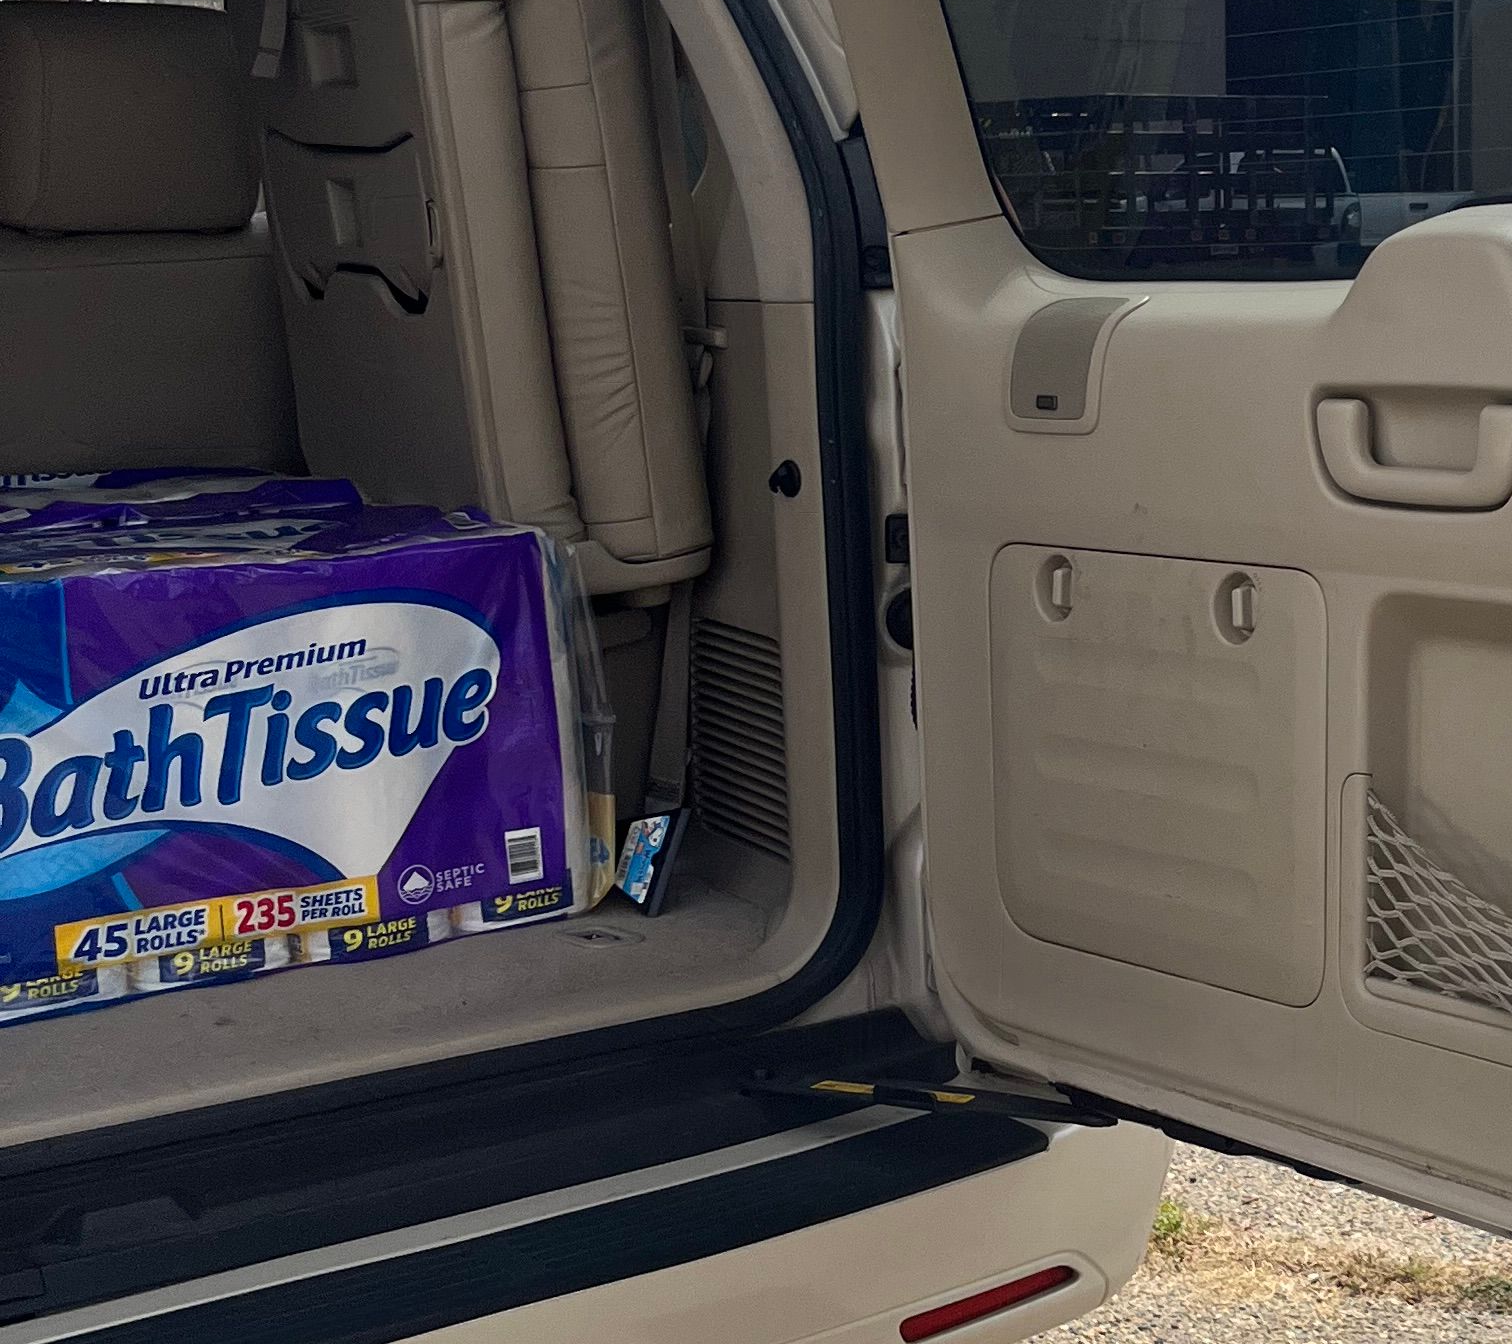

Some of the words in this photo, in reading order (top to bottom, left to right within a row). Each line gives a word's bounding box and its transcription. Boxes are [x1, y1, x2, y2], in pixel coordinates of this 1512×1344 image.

[139, 668, 219, 700] Ultra
[224, 638, 367, 684] Premium
[435, 863, 485, 882] SEPTIC
[436, 875, 472, 893] SAFE
[300, 888, 363, 909] SHEETS
[134, 908, 206, 936] LARGE
[237, 894, 296, 935] 235
[301, 907, 329, 921] PER
[330, 902, 365, 918] ROLL
[366, 915, 417, 937] LARGE
[73, 922, 128, 962] 45
[199, 940, 252, 960] LARGE
[343, 928, 363, 953] 9
[174, 951, 194, 975] 9
[200, 954, 248, 974] ROLLS
[27, 980, 80, 1001] ROLLS
